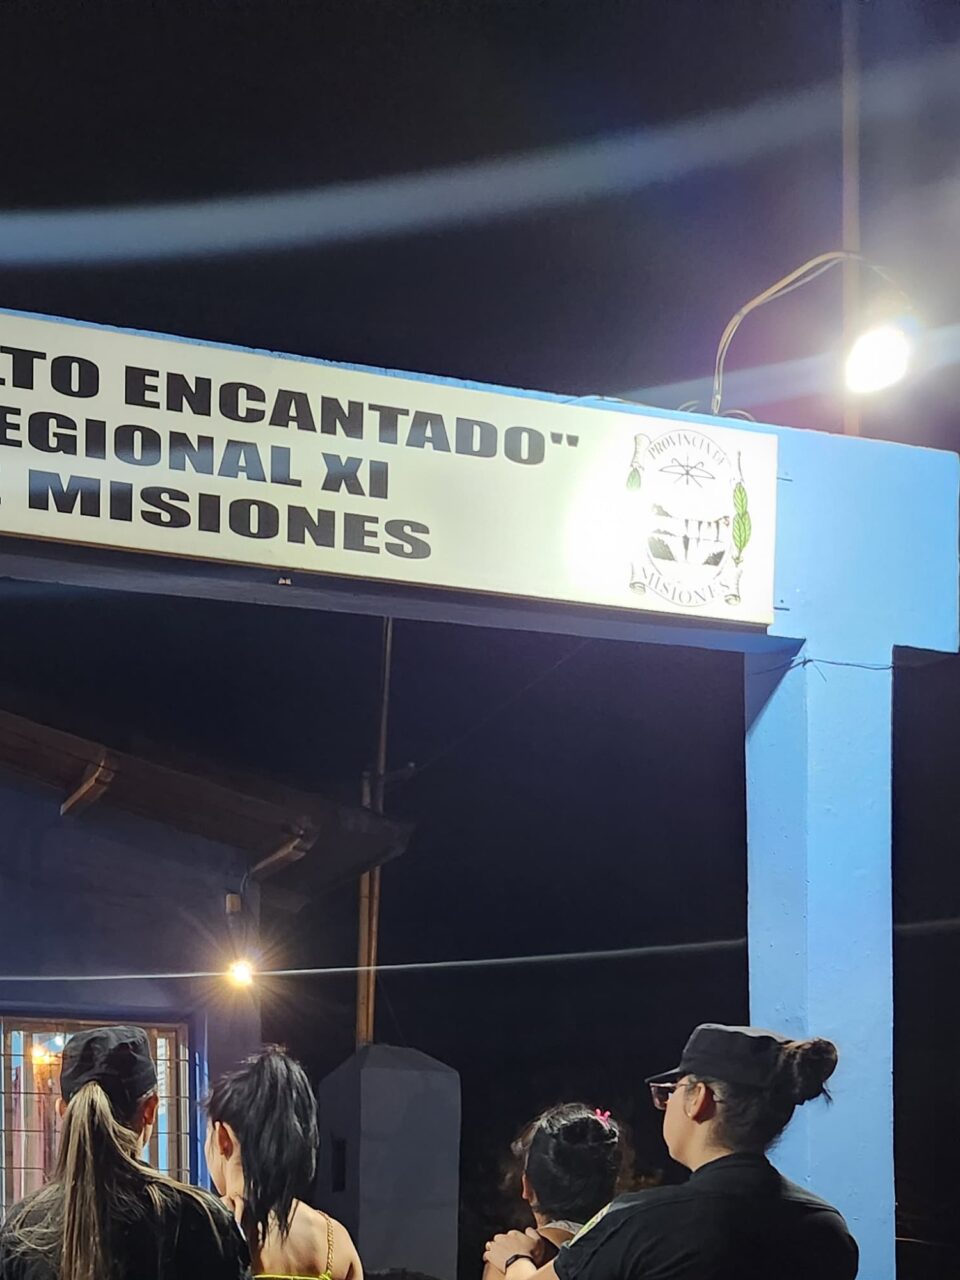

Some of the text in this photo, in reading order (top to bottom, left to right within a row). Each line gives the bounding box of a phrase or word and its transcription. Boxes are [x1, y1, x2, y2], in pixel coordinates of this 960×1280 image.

[124, 365, 581, 465] ENCANTADO"
[27, 469, 433, 560] MISIONES
[321, 451, 390, 500] XI
